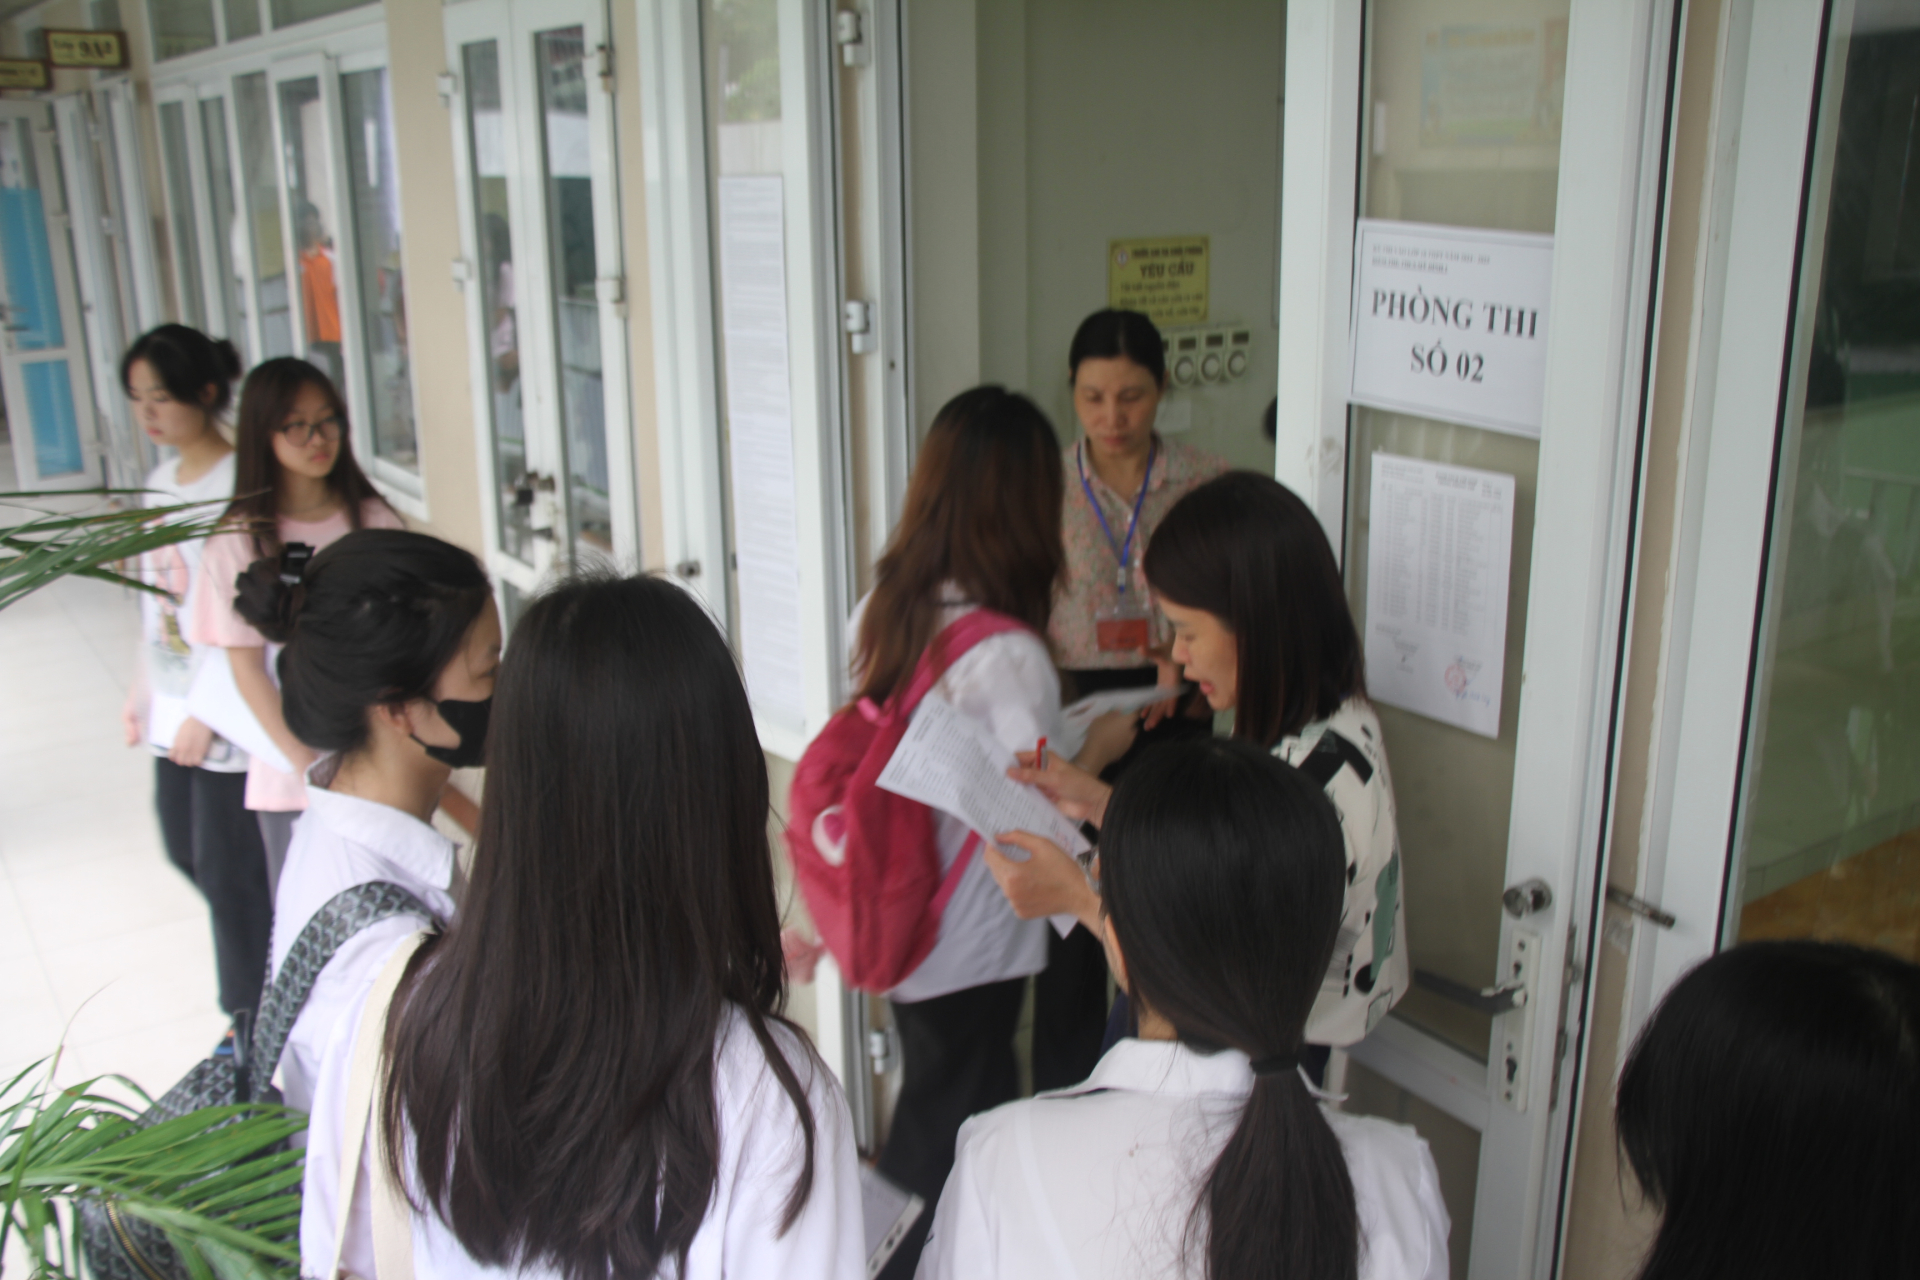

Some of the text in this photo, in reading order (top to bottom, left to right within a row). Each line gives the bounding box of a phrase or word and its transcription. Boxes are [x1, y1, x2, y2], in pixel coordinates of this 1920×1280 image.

[1371, 285, 1538, 339] PHÒNG THI
[1411, 339, 1484, 384] SỐ 02
